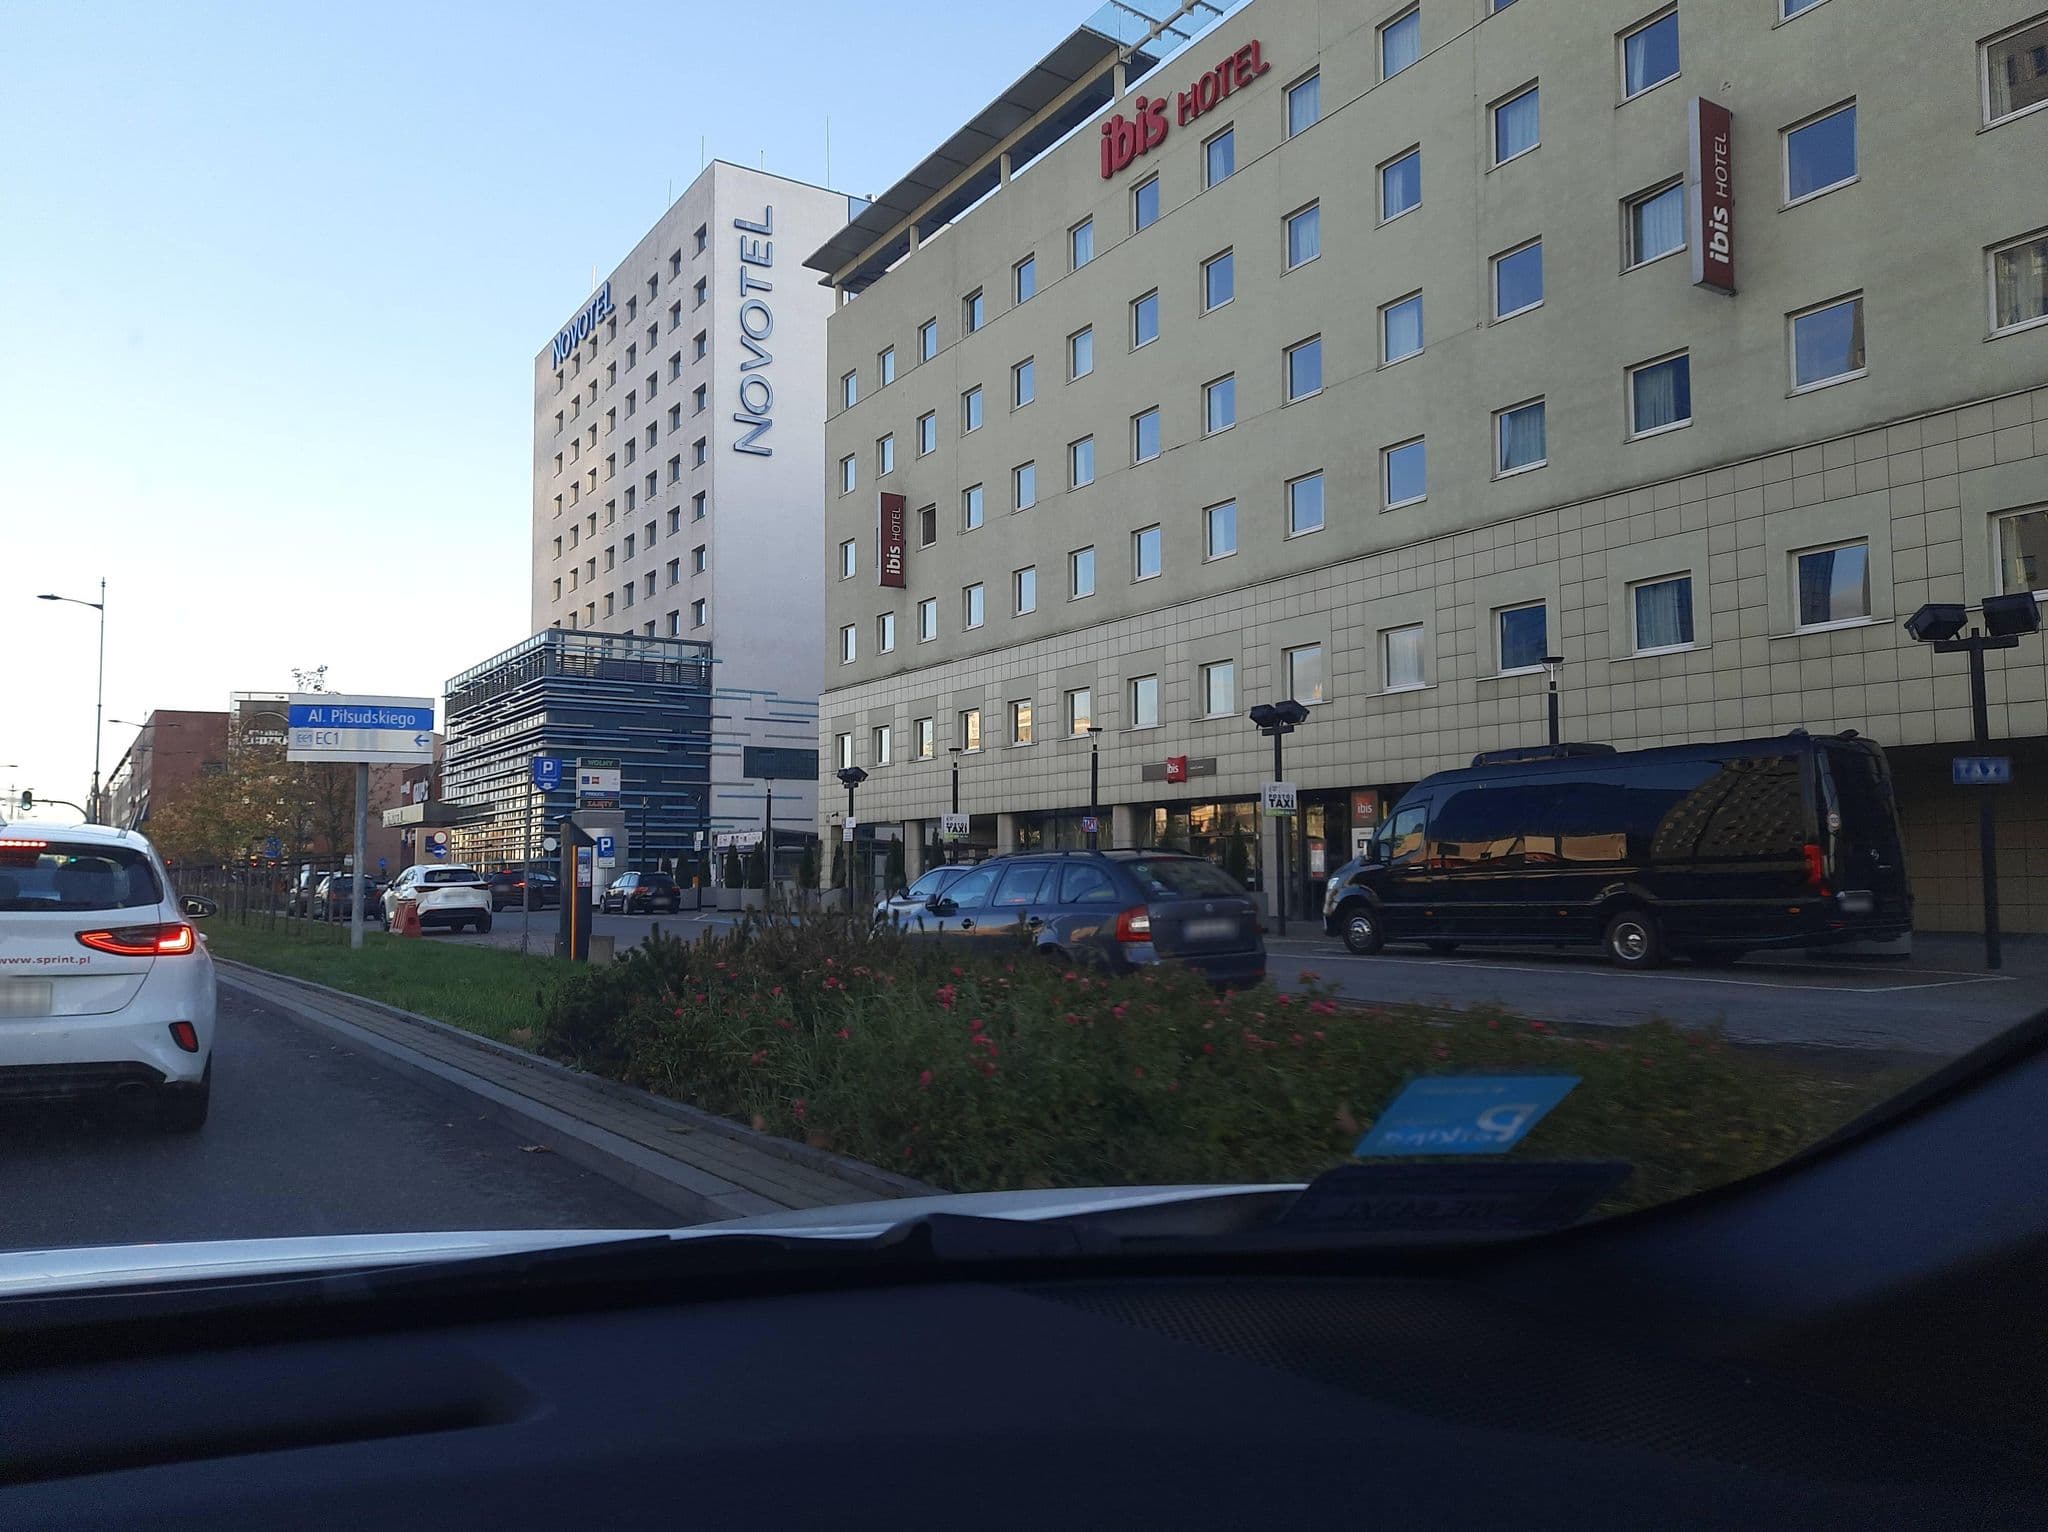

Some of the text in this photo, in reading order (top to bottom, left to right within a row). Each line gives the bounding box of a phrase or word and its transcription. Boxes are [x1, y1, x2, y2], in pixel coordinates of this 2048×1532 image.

[1101, 39, 1271, 179] ibis HOTEL
[1709, 132, 1730, 264] ibis HOTEL
[552, 280, 616, 370] NOVOTEL
[733, 204, 774, 457] NOVOTEL
[886, 507, 901, 575] ibis HOTEL
[308, 709, 416, 728] Al. Piłsudskiego
[315, 731, 339, 745] EC1
[543, 761, 553, 774] P
[1269, 799, 1294, 808] TAXI
[1357, 803, 1373, 814] ibis
[601, 838, 611, 851] P
